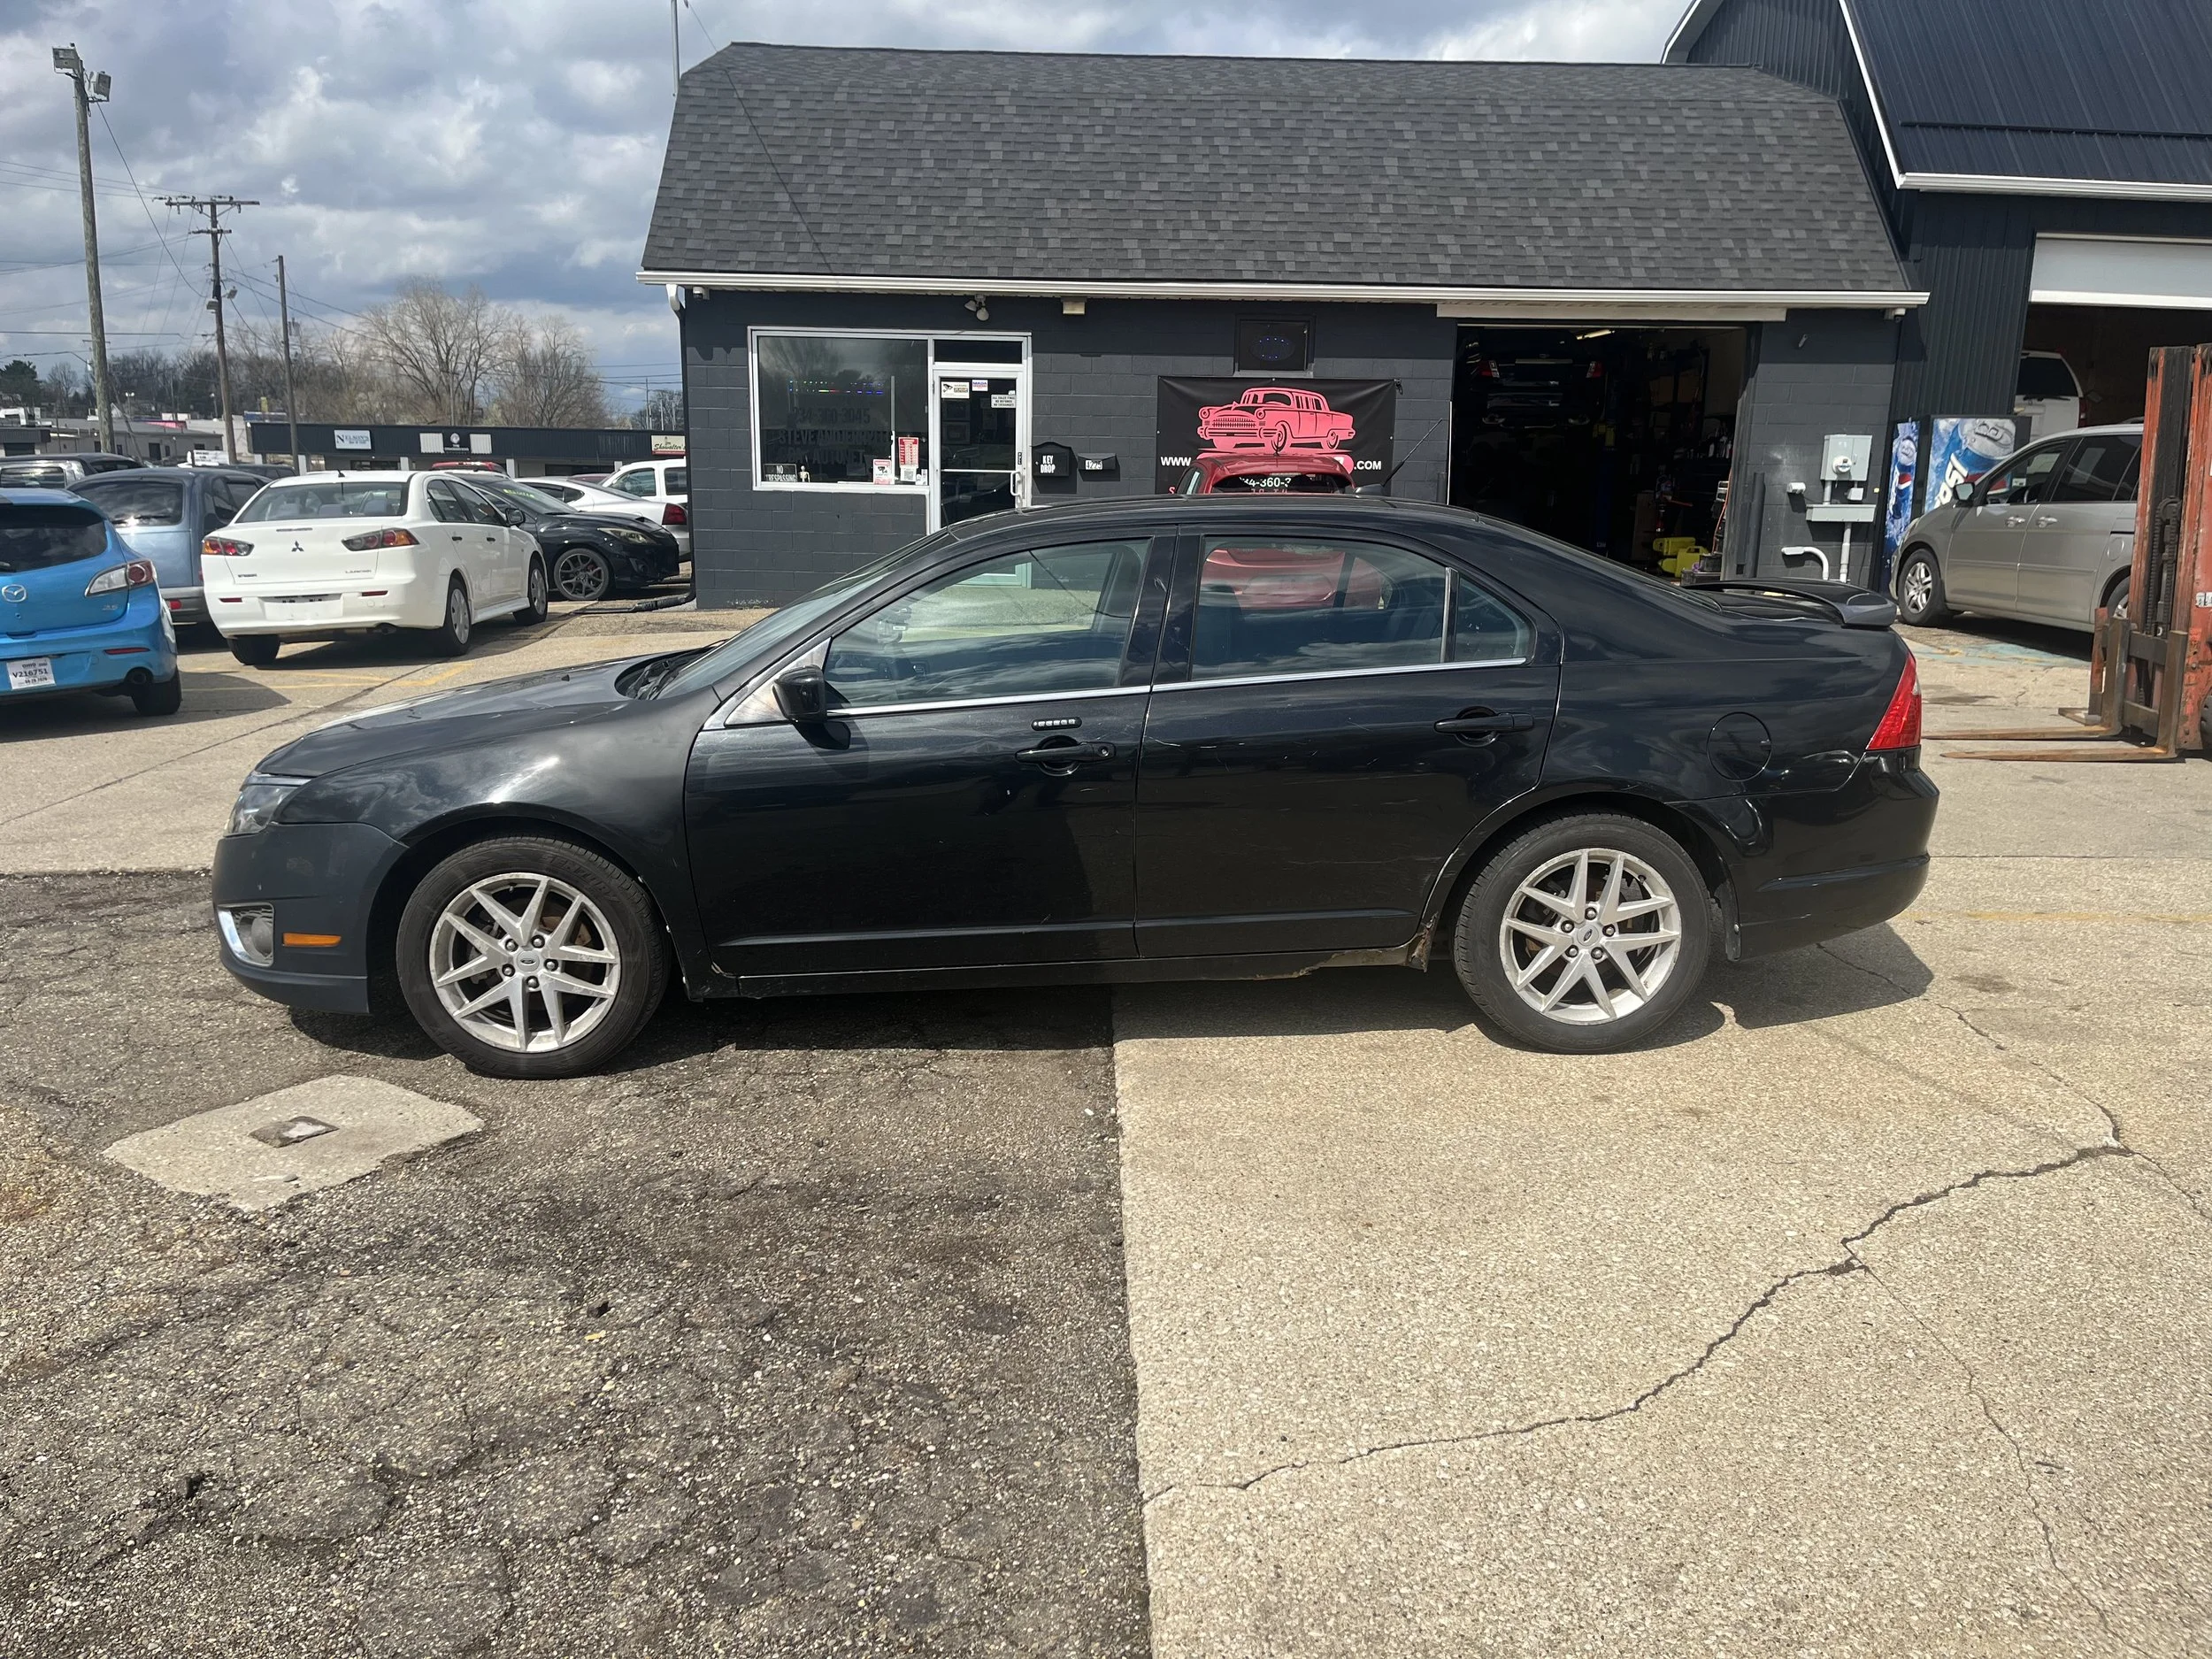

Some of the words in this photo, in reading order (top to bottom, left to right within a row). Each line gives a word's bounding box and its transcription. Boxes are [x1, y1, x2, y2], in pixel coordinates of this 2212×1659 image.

[1042, 455, 1054, 465] KEY
[776, 465, 784, 474] NO
[1040, 464, 1056, 473] DROP
[1354, 460, 1382, 471] .COM
[765, 473, 796, 482] TRESPASSING
[12, 668, 49, 678] V216751
